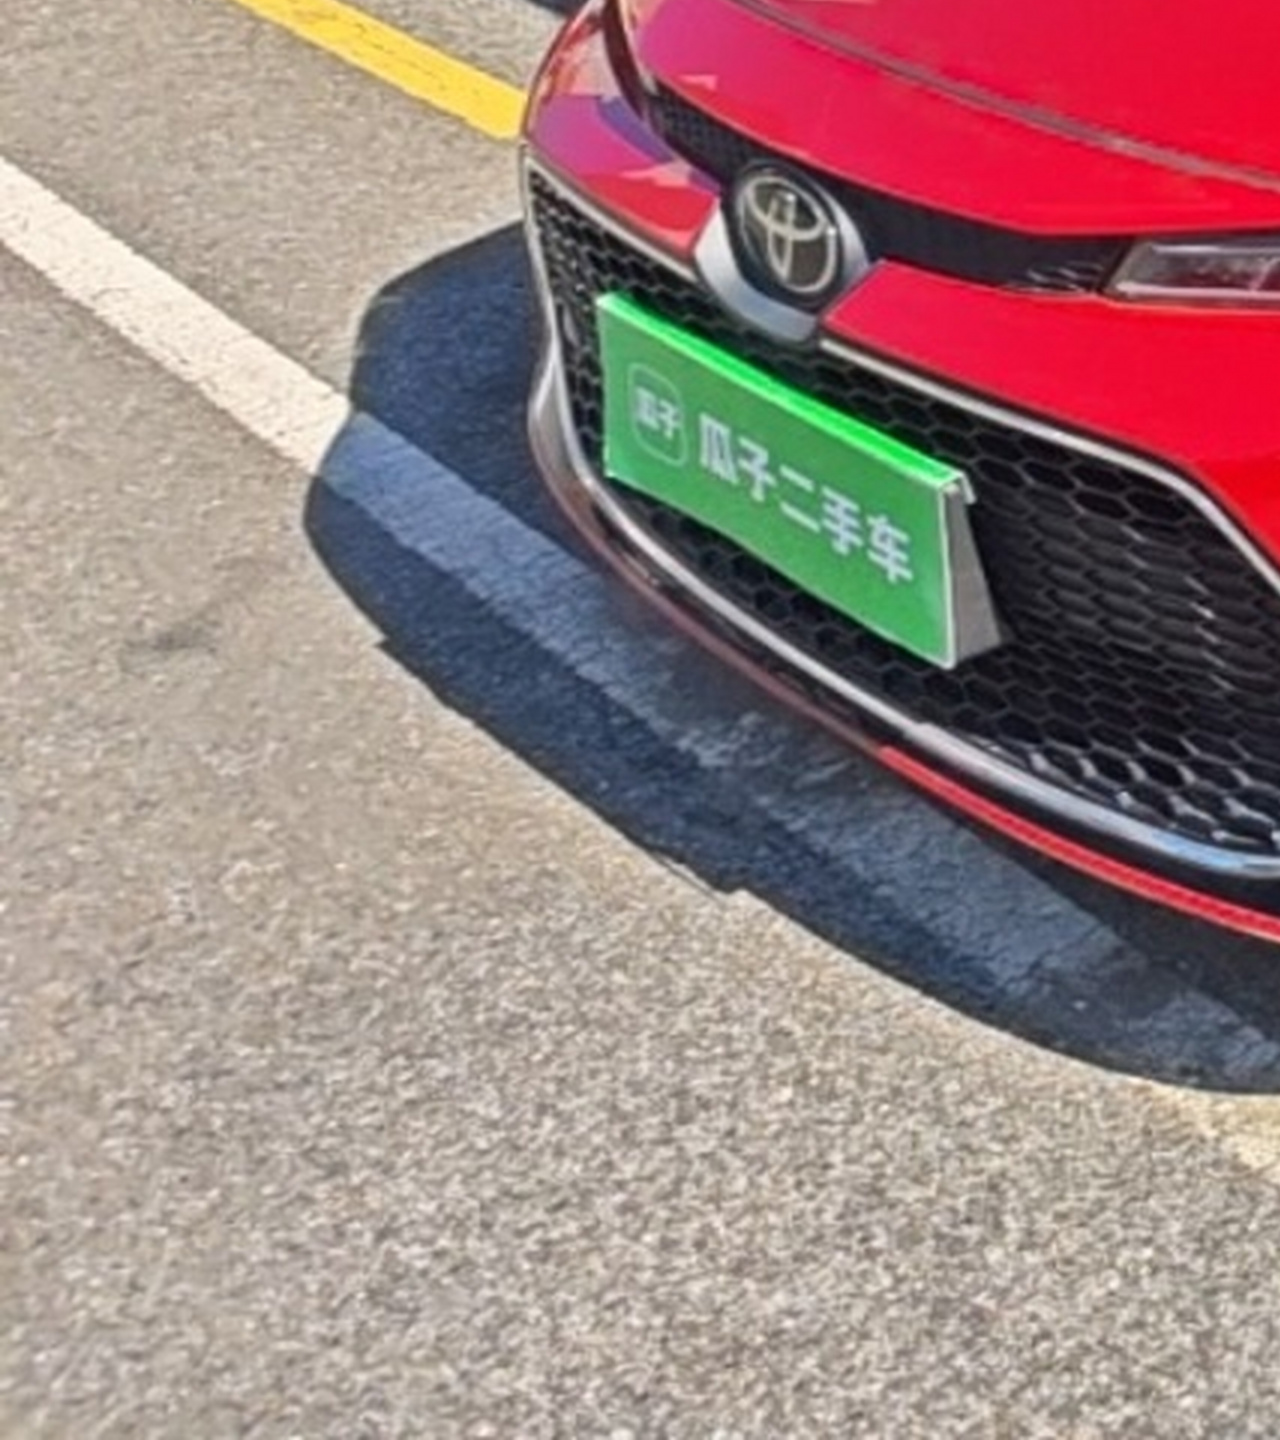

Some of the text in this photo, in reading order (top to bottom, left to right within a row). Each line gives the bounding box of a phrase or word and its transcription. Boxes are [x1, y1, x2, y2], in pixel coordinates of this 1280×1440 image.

[700, 412, 913, 583] 瓜子二手车
